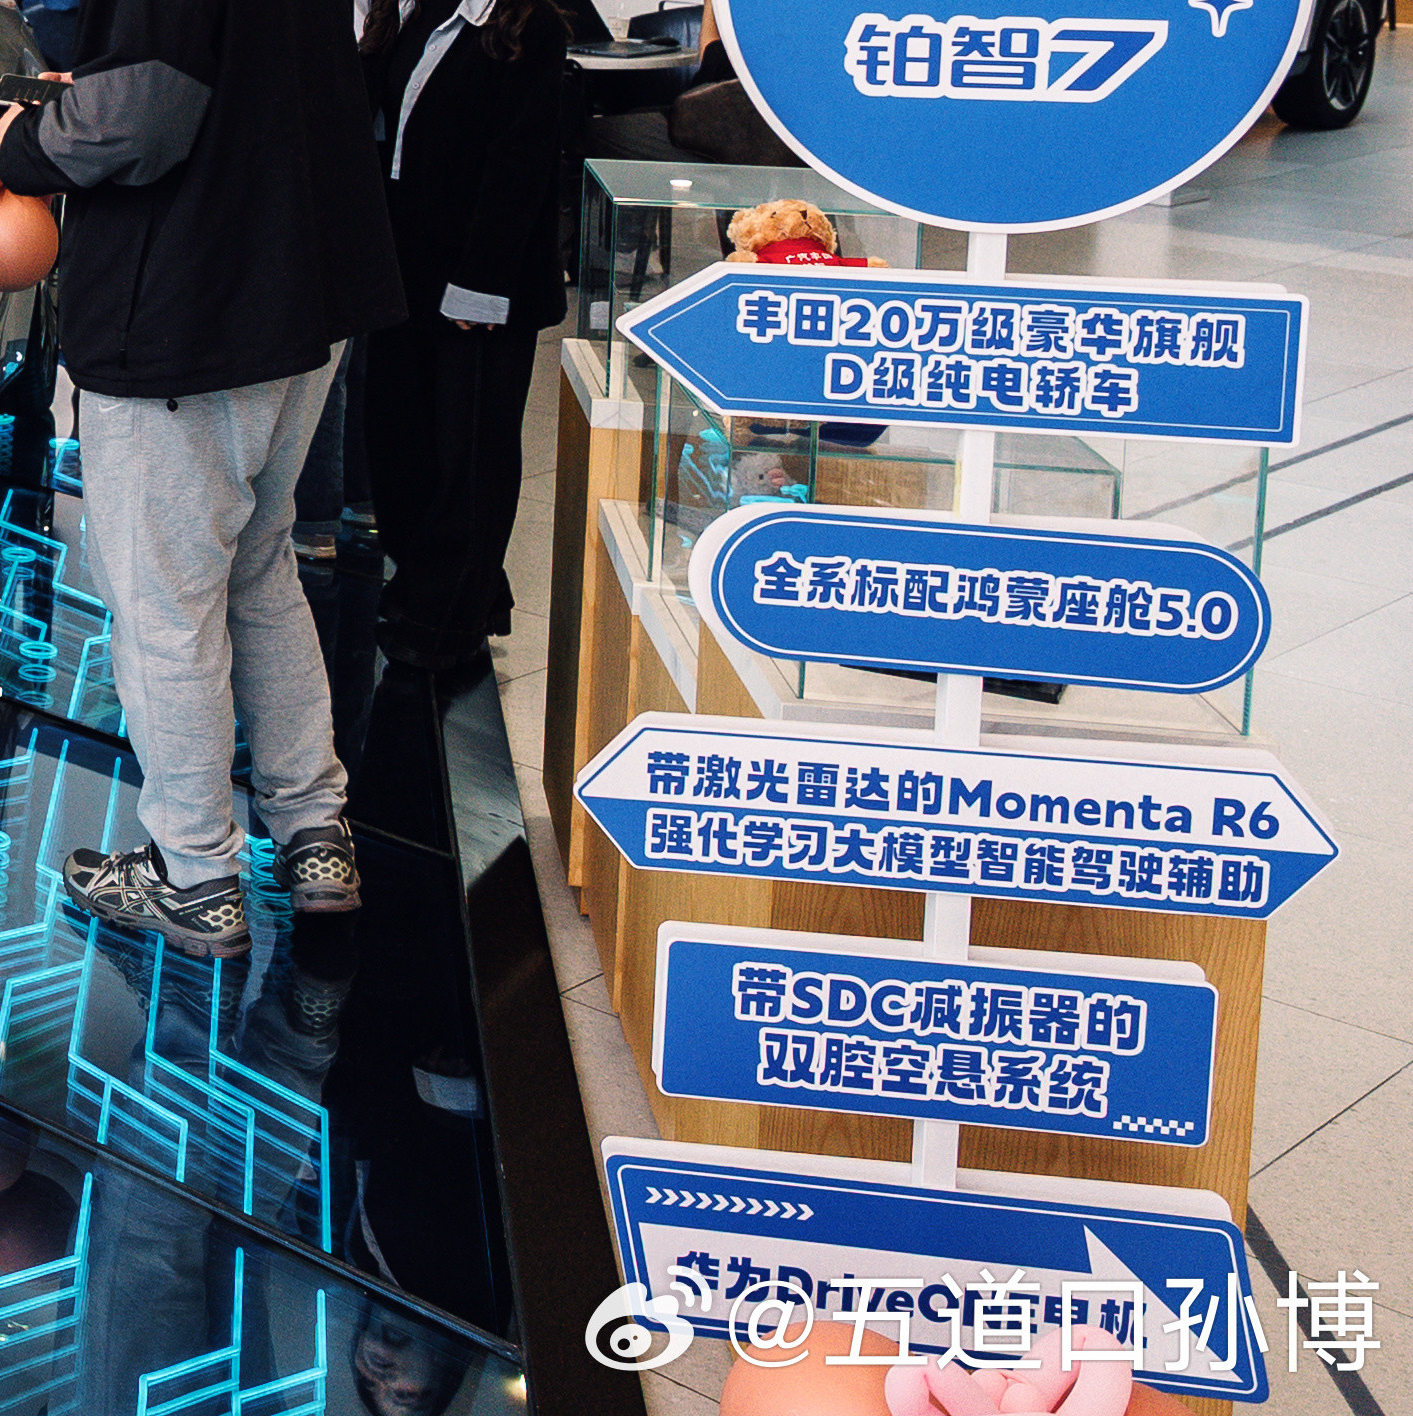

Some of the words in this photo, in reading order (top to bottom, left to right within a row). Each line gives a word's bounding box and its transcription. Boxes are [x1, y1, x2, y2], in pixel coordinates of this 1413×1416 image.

[854, 21, 1161, 95] 铂智7
[741, 291, 1244, 367] 丰田20万级豪华旗舰
[827, 355, 1139, 415] D级纯电轿车
[755, 554, 1239, 639] 全系标配鸿蒙座舱5.0
[646, 751, 1191, 834] 带激光雷达的Momenta
[1211, 794, 1281, 841] R6
[649, 812, 1268, 904] 强化学习大模型智能驾驶辅助
[734, 965, 1145, 1051] 带SDC减振器的
[761, 1033, 1111, 1116] 双腔空悬系统
[676, 1251, 1149, 1348] 华为DriveONE电机
